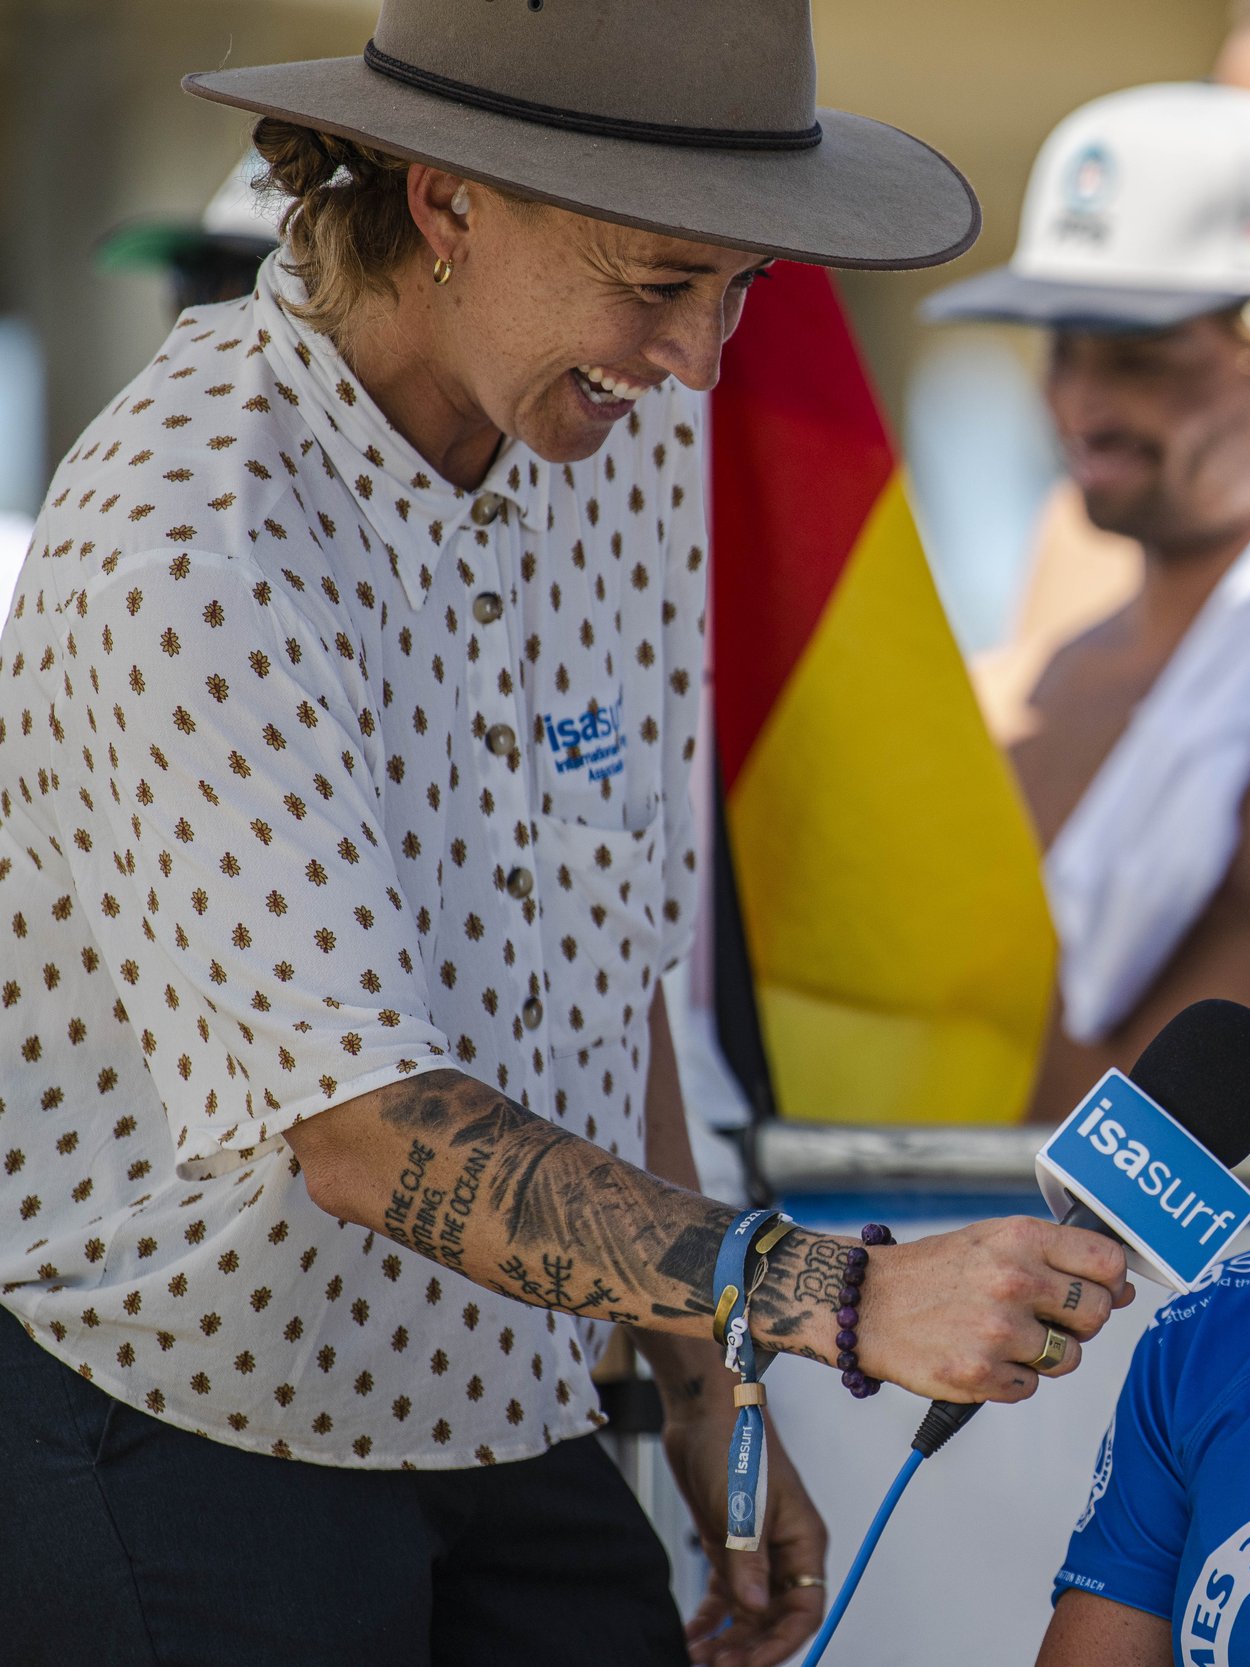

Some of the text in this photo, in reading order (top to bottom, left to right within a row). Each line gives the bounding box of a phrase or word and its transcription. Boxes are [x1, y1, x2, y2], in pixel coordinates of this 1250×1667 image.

[385, 1190, 413, 1223] THE
[401, 1140, 435, 1191] CURE
[1077, 1098, 1236, 1245] isasurf
[440, 1213, 464, 1245] THE
[735, 1212, 761, 1235] 2022
[1075, 1574, 1105, 1591] BEACH
